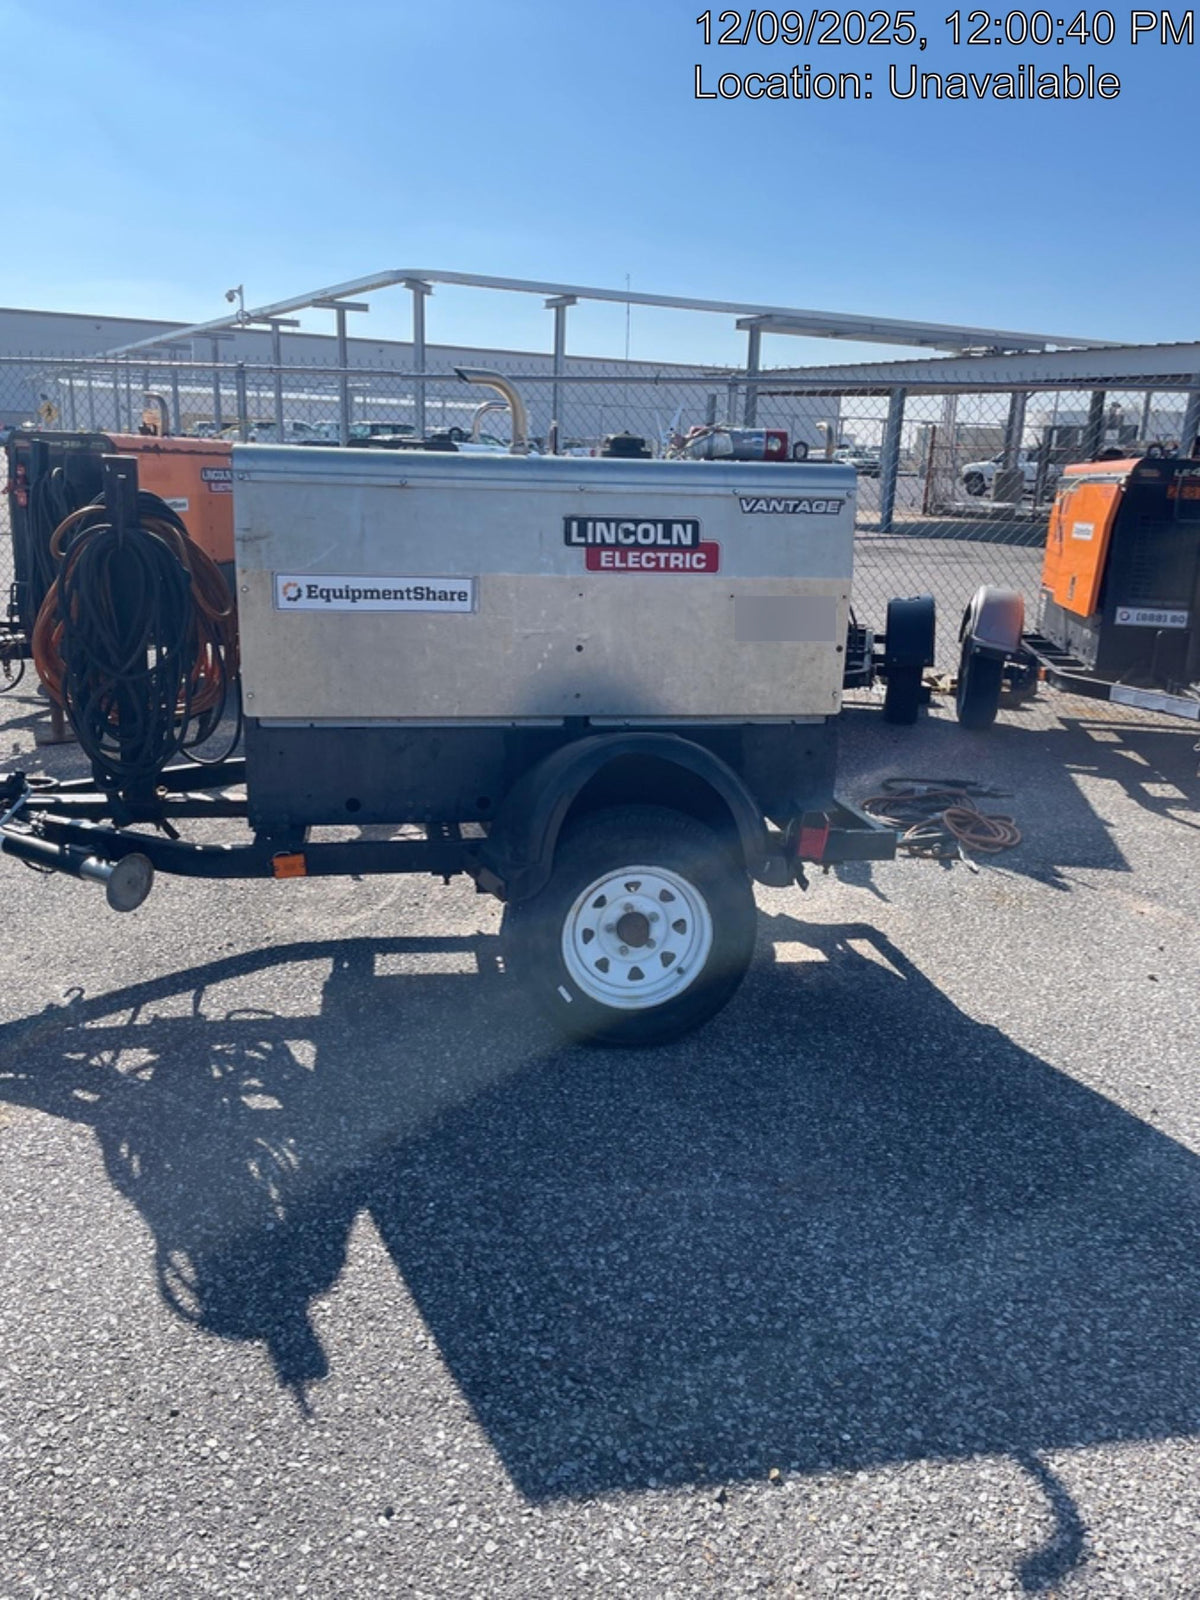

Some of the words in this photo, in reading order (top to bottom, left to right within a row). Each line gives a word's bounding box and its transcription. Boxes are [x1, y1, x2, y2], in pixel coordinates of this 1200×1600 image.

[740, 498, 842, 514] VANTAGE
[571, 520, 693, 546] LINCOLN
[600, 550, 707, 570] ELECTRIC
[305, 584, 469, 603] EquipmentShare
